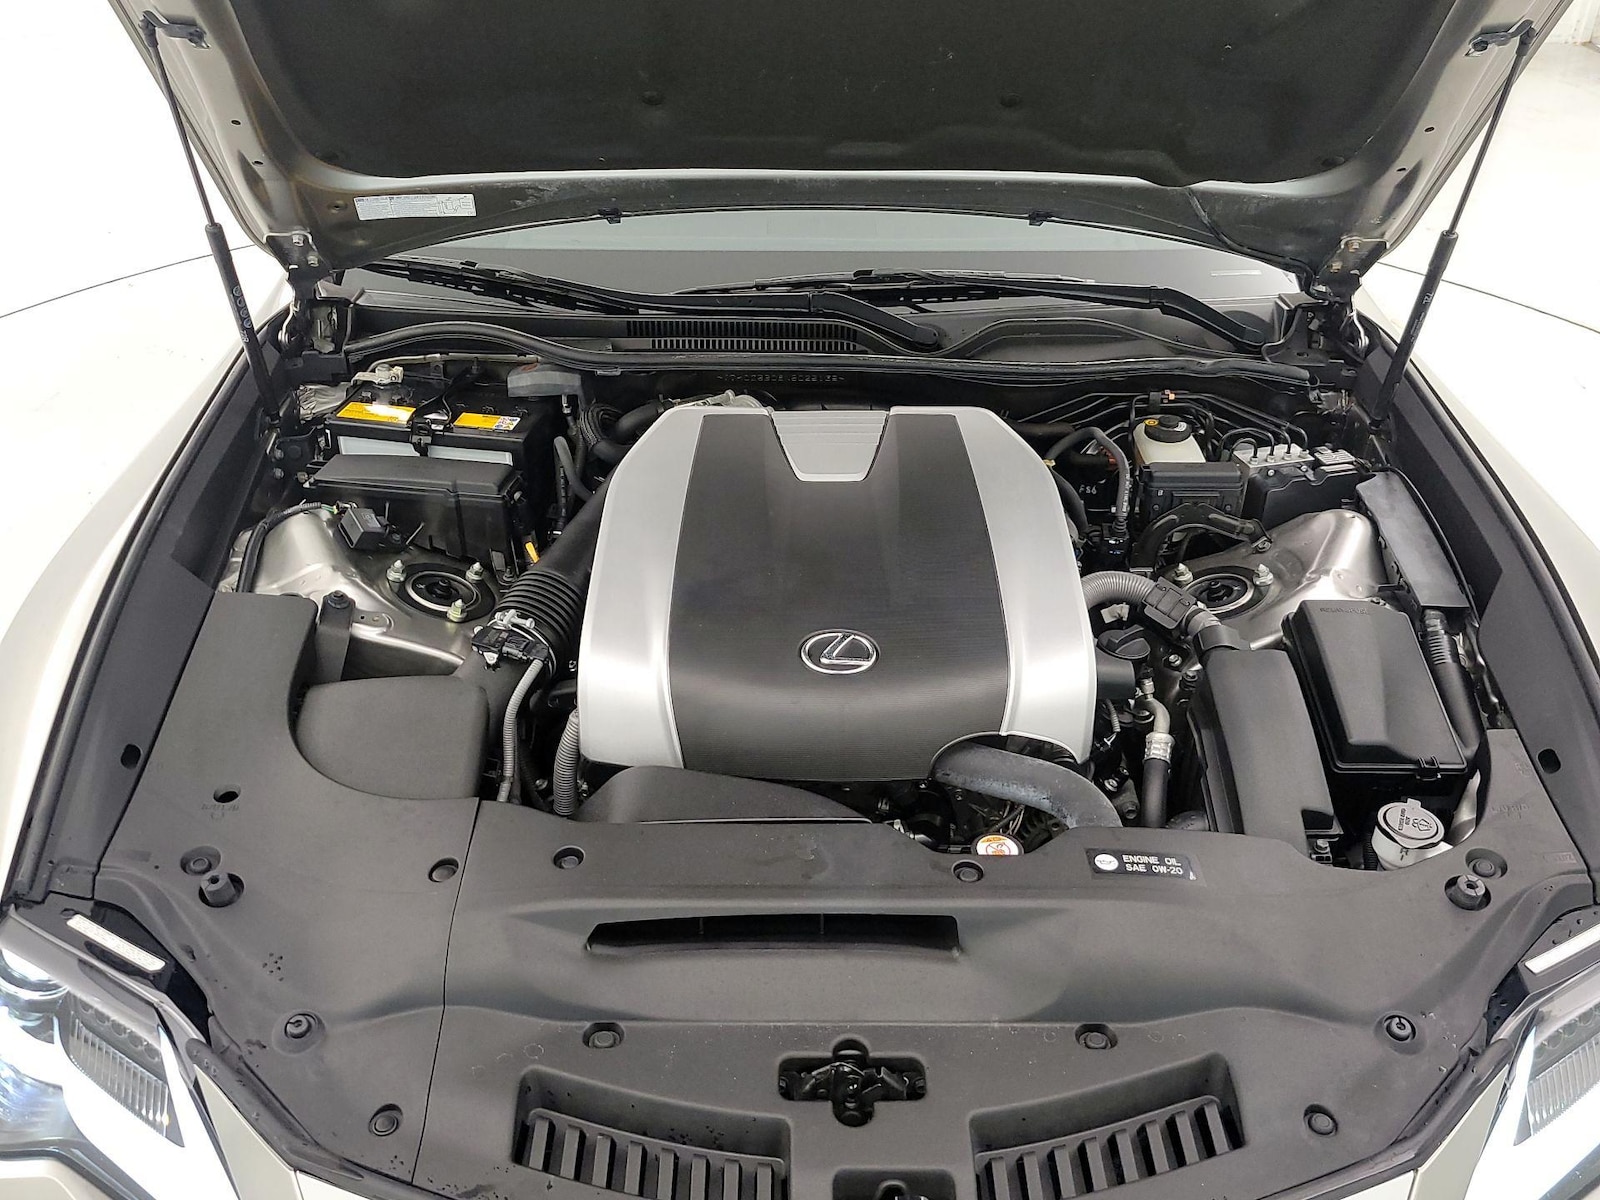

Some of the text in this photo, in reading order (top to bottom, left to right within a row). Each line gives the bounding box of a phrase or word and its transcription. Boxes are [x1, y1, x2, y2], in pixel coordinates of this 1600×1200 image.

[1122, 854, 1181, 866] ENGINE OIL
[1125, 863, 1147, 872] SAE
